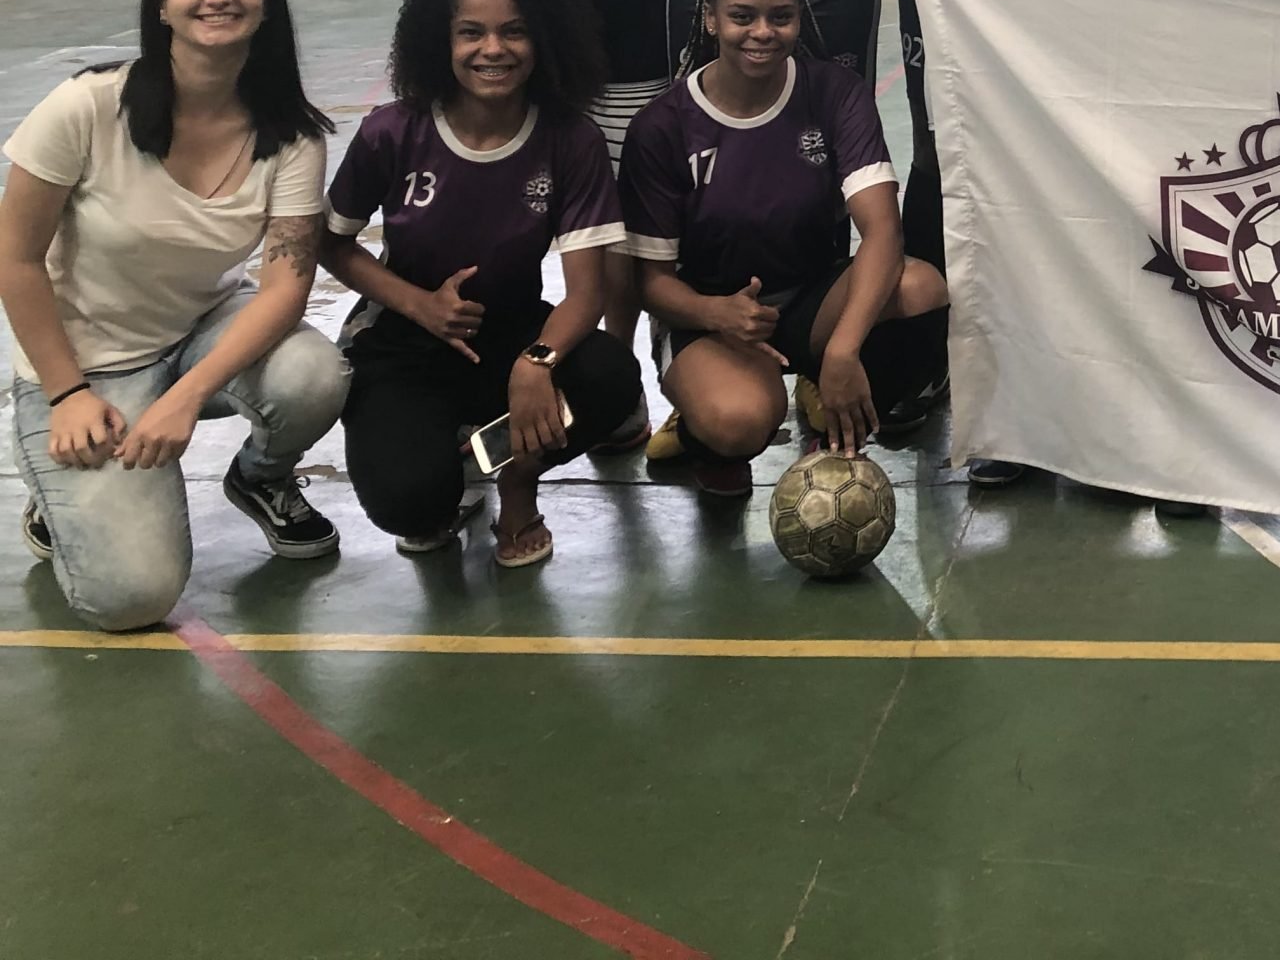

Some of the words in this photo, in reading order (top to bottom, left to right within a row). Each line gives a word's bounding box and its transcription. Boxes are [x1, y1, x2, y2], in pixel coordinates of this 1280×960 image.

[902, 33, 923, 67] 92
[687, 147, 718, 189] 17
[404, 171, 437, 207] 13
